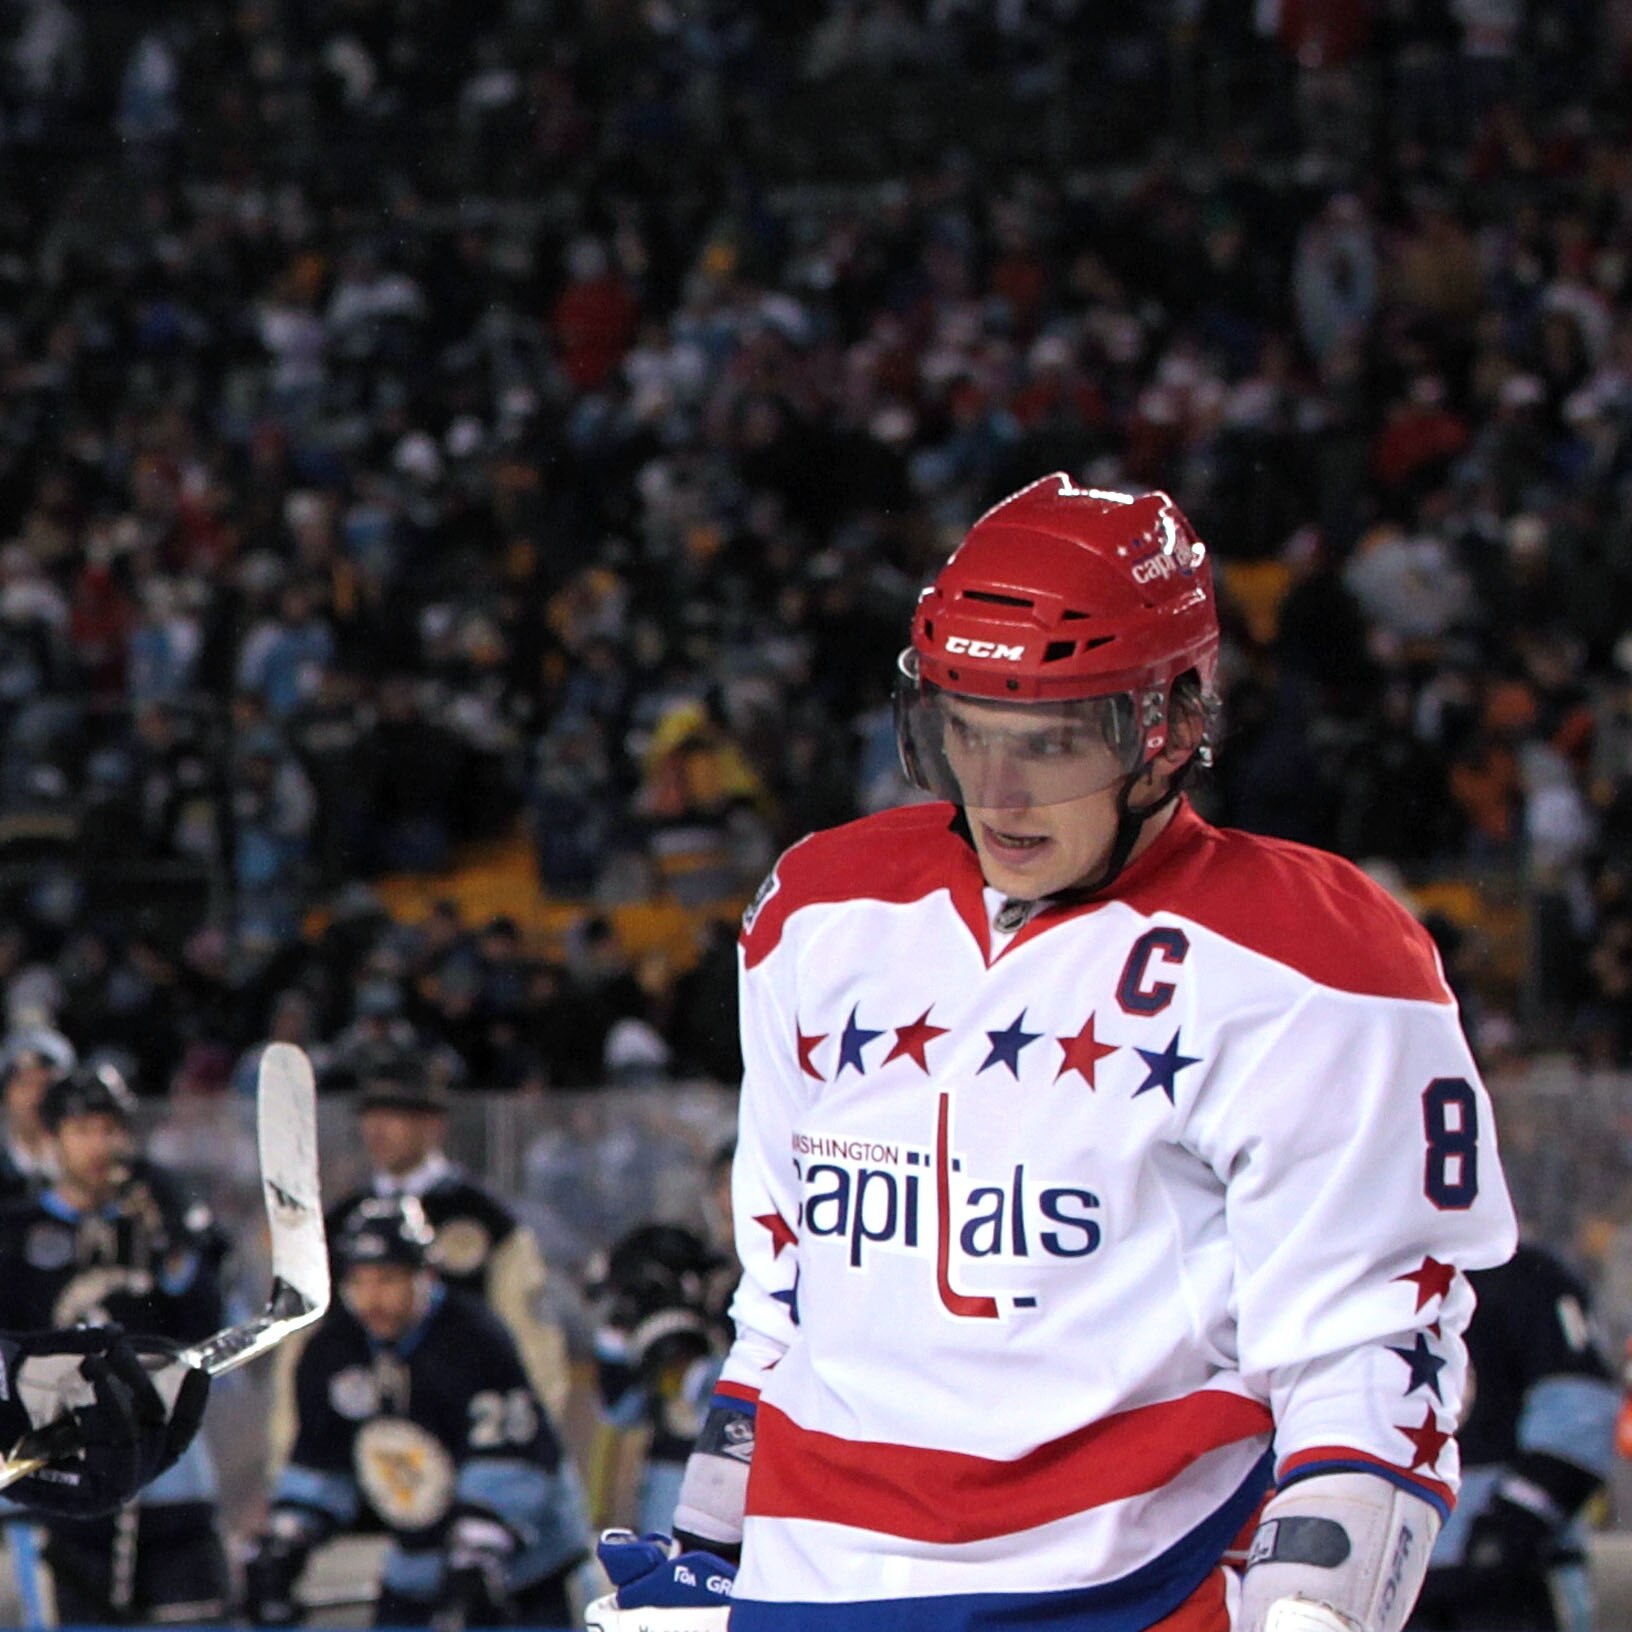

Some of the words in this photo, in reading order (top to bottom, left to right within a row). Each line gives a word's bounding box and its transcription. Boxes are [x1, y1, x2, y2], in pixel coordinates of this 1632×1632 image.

[945, 635, 1025, 661] CCM
[1114, 927, 1190, 1016] C
[1421, 1077, 1479, 1212] 8
[793, 1092, 1101, 1319] apitals
